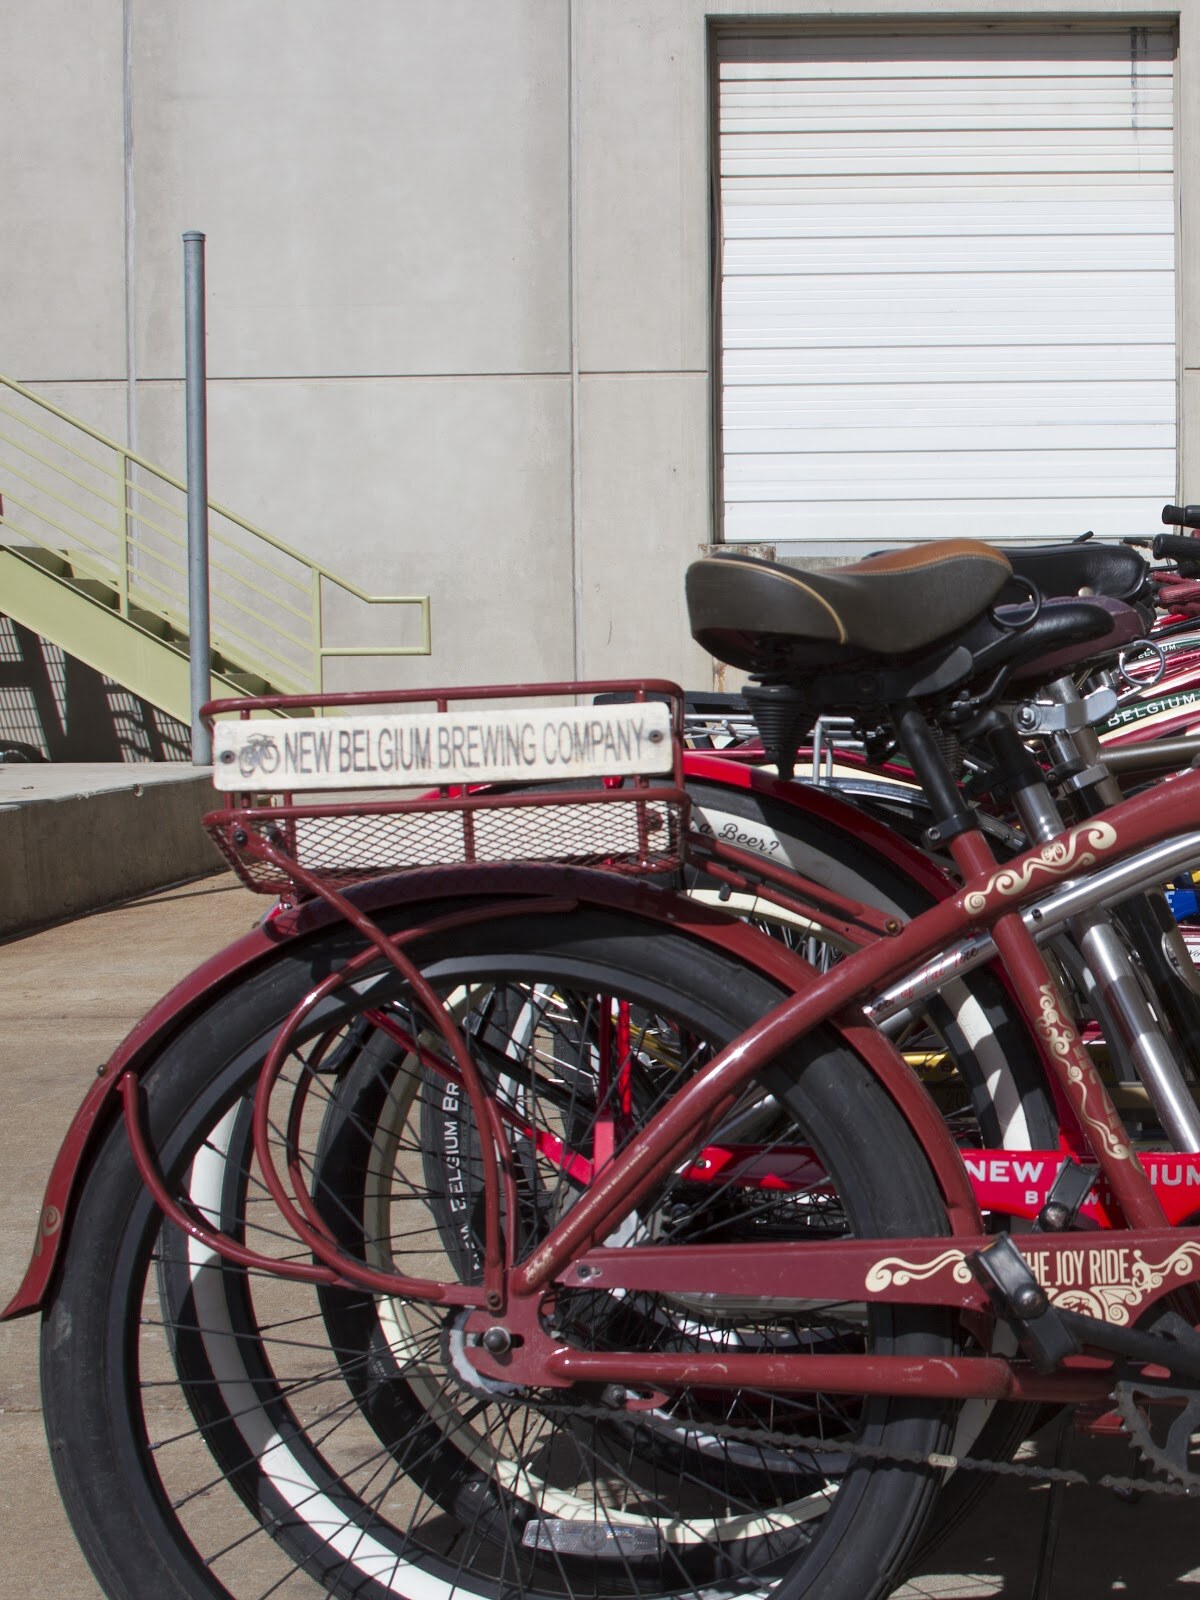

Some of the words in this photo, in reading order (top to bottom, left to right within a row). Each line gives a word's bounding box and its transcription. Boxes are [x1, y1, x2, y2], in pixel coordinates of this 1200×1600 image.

[1107, 693, 1196, 727] BELGIUM
[284, 730, 333, 774] NEW
[339, 727, 432, 773] BELGIUM
[438, 722, 536, 769] BREWING
[543, 718, 645, 766] COMPANY
[699, 823, 713, 835] a
[718, 822, 780, 855] Beer?
[965, 1160, 1044, 1183] NEW
[1055, 1249, 1085, 1287] JOY
[1089, 1248, 1132, 1284] RIDE
